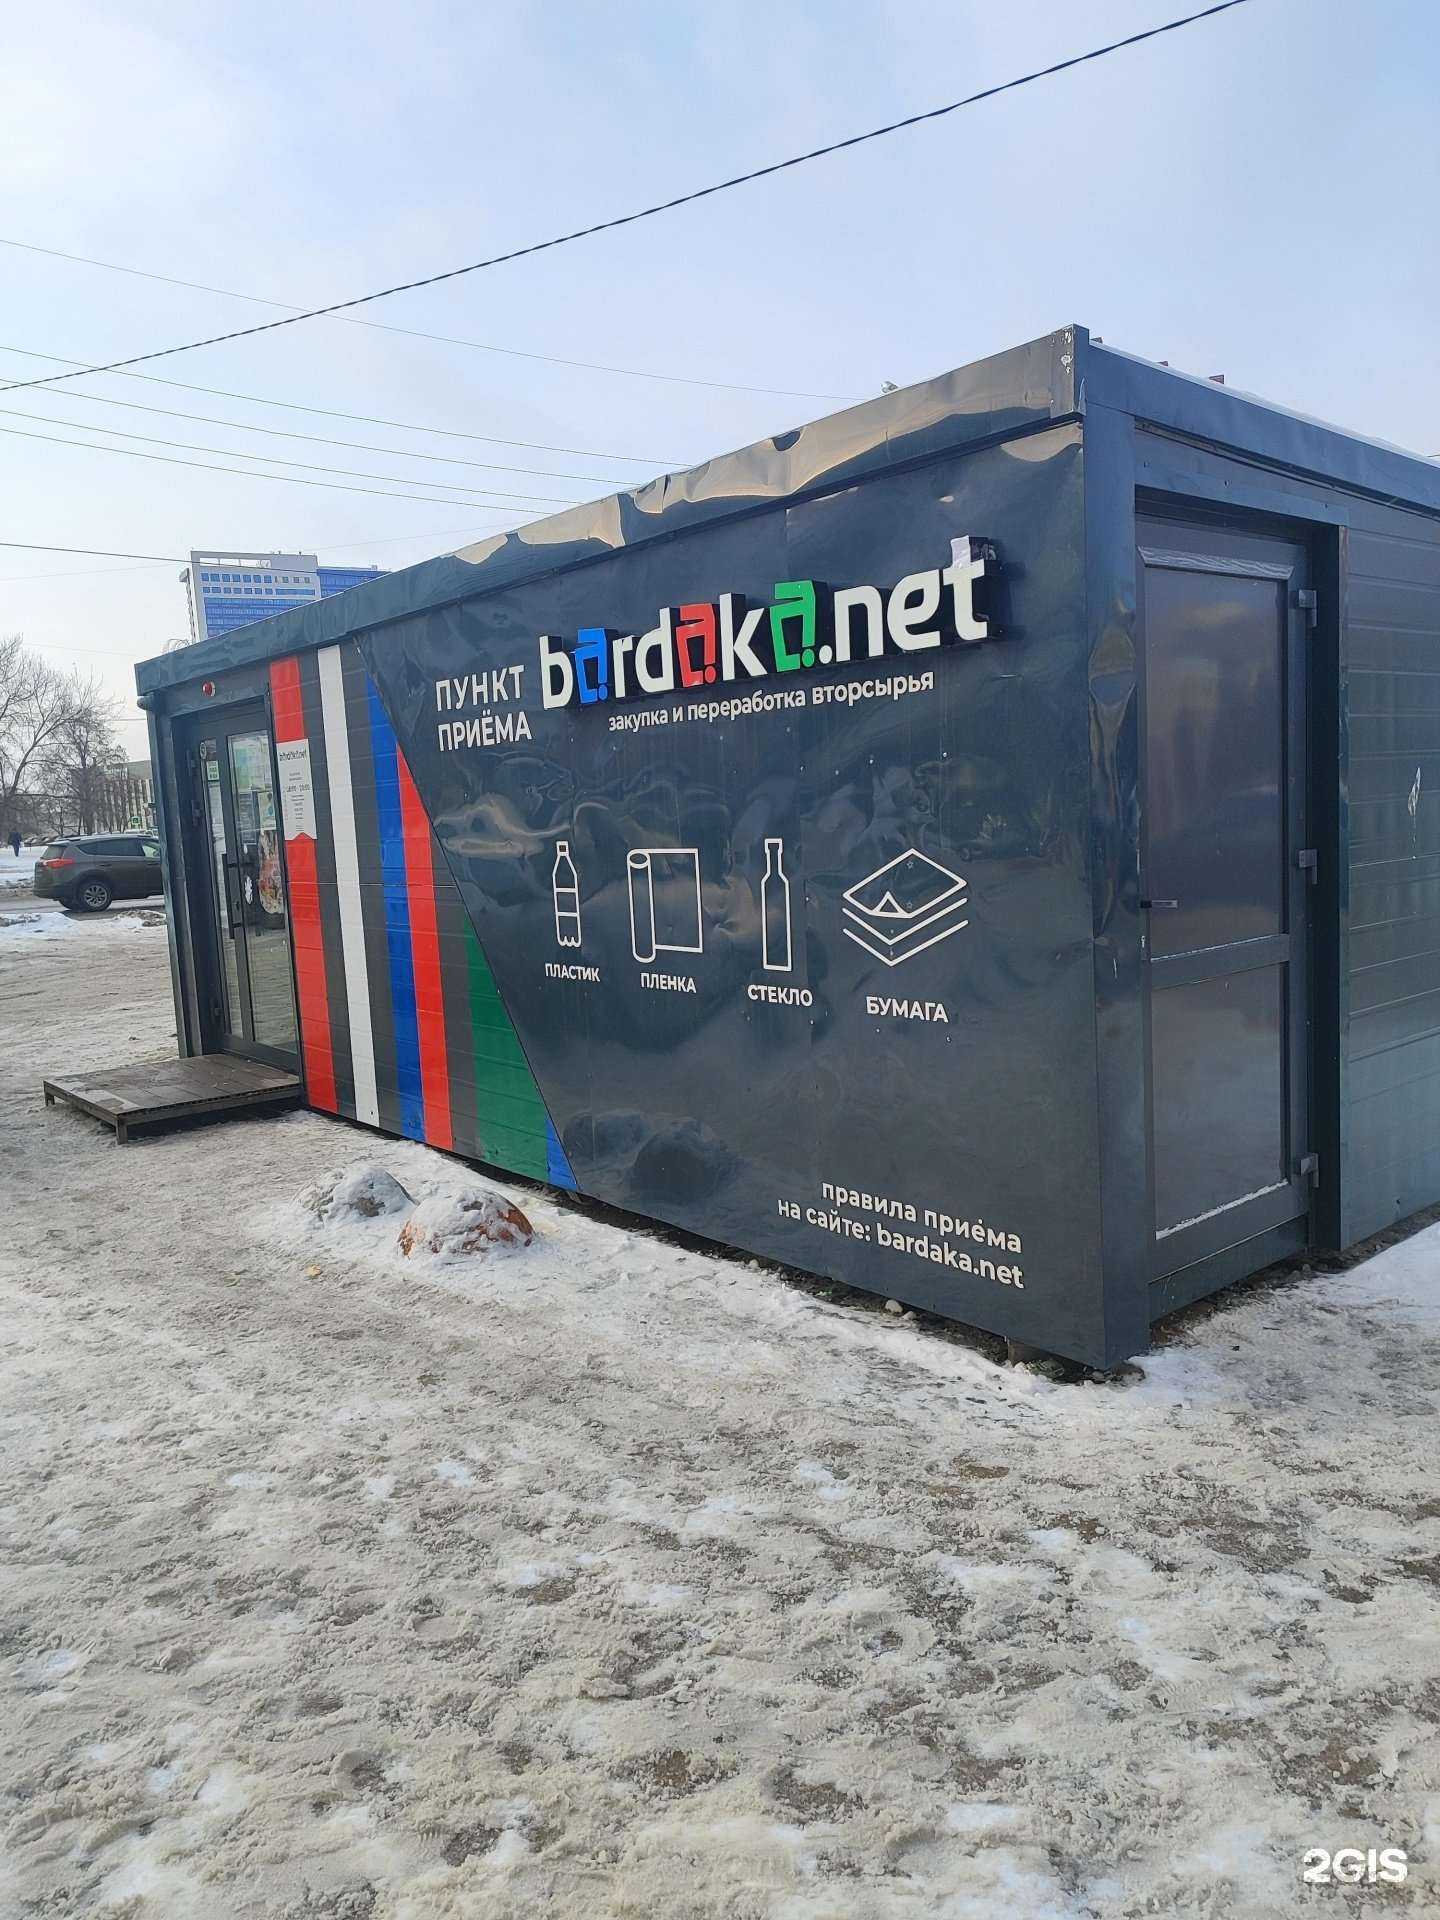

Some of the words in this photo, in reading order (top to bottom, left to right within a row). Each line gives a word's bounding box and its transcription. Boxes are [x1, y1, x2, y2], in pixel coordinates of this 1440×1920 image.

[539, 535, 988, 709] bardaka.net
[435, 664, 525, 712] ПУНКТ
[608, 708, 669, 733] закупка
[673, 705, 684, 722] и
[687, 688, 806, 722] переработка
[812, 671, 934, 706] вторсырья
[437, 708, 533, 752] ПРИЁМА
[544, 962, 600, 983] ПЛАСТИК
[640, 972, 697, 994] ПЛЕНКА
[747, 984, 813, 1007] СТЕКЛО
[866, 996, 949, 1023] БУМАГА
[821, 1181, 917, 1222] правила
[777, 1199, 801, 1221] на
[806, 1207, 872, 1241] сайте:
[876, 1223, 1025, 1288] bardaka.net
